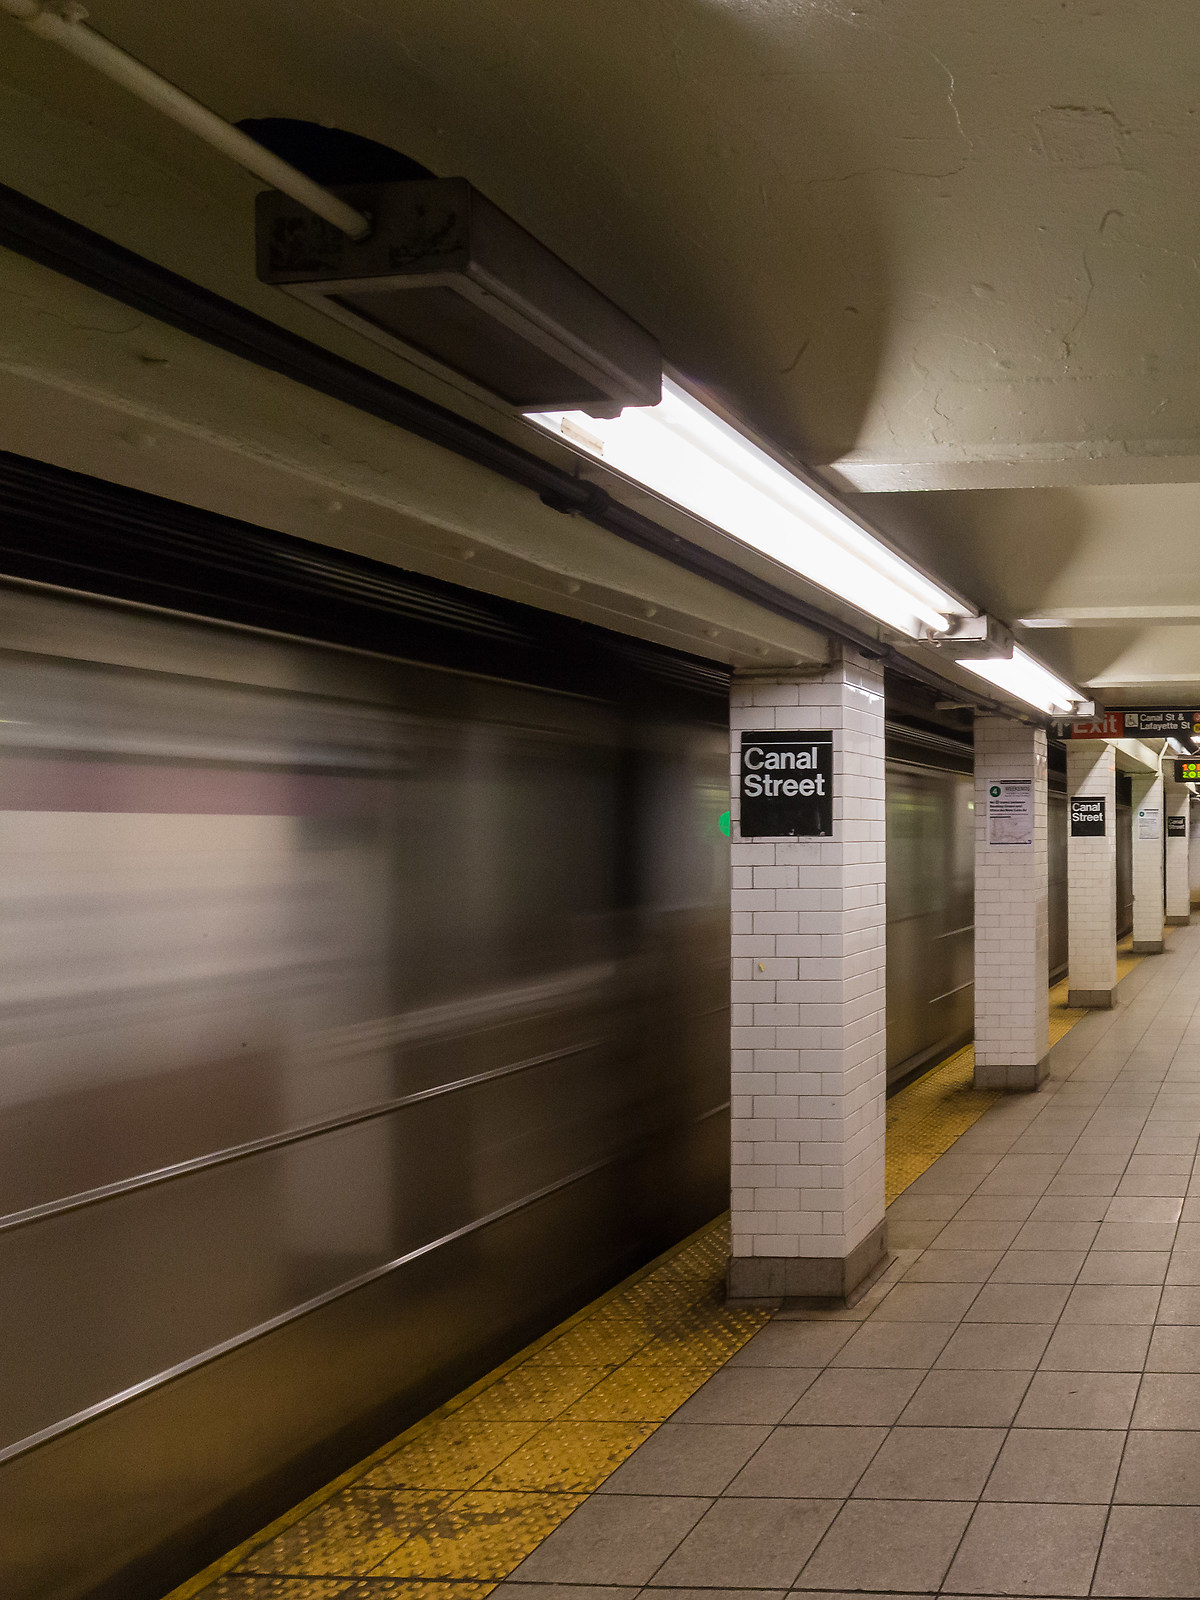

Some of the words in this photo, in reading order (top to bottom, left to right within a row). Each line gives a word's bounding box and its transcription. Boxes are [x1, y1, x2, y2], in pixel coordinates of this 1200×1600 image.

[1140, 713, 1163, 722] Canal
[1165, 713, 1175, 722] St
[1178, 713, 1185, 721] &
[1073, 714, 1118, 734] Exit
[1140, 722, 1178, 731] Lafayette
[1181, 721, 1191, 730] St
[744, 747, 818, 770] Canal
[744, 773, 826, 797] Street
[1072, 802, 1101, 812] Canal
[1072, 812, 1104, 822] Street
